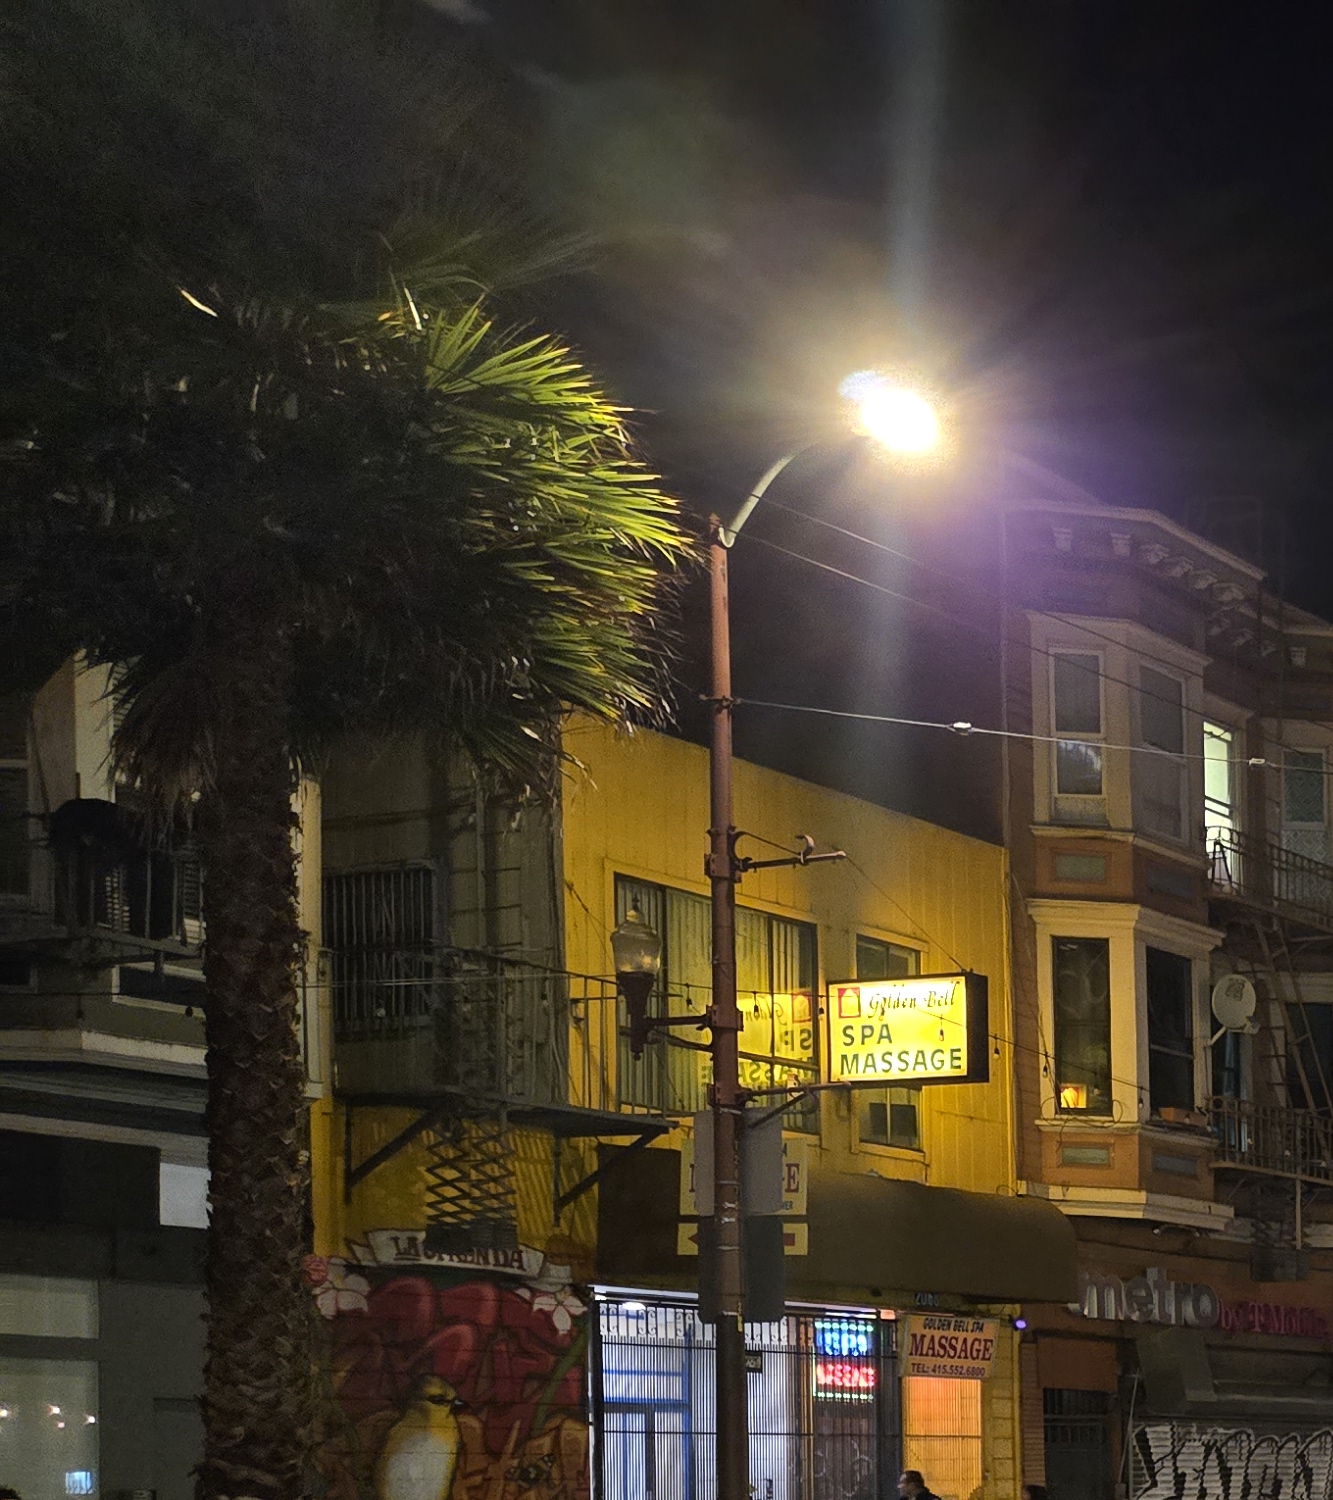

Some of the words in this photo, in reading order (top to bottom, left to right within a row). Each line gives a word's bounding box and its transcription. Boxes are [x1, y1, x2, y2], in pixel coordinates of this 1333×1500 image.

[842, 1023, 893, 1046] SPA
[840, 1048, 962, 1075] MASSAGE
[1076, 1267, 1219, 1328] metro
[924, 1317, 952, 1331] GOLDEN
[953, 1319, 969, 1332] BELL
[970, 1321, 984, 1333] SPA
[909, 1333, 994, 1361] MASSAGE
[911, 1363, 930, 1374] TEL:
